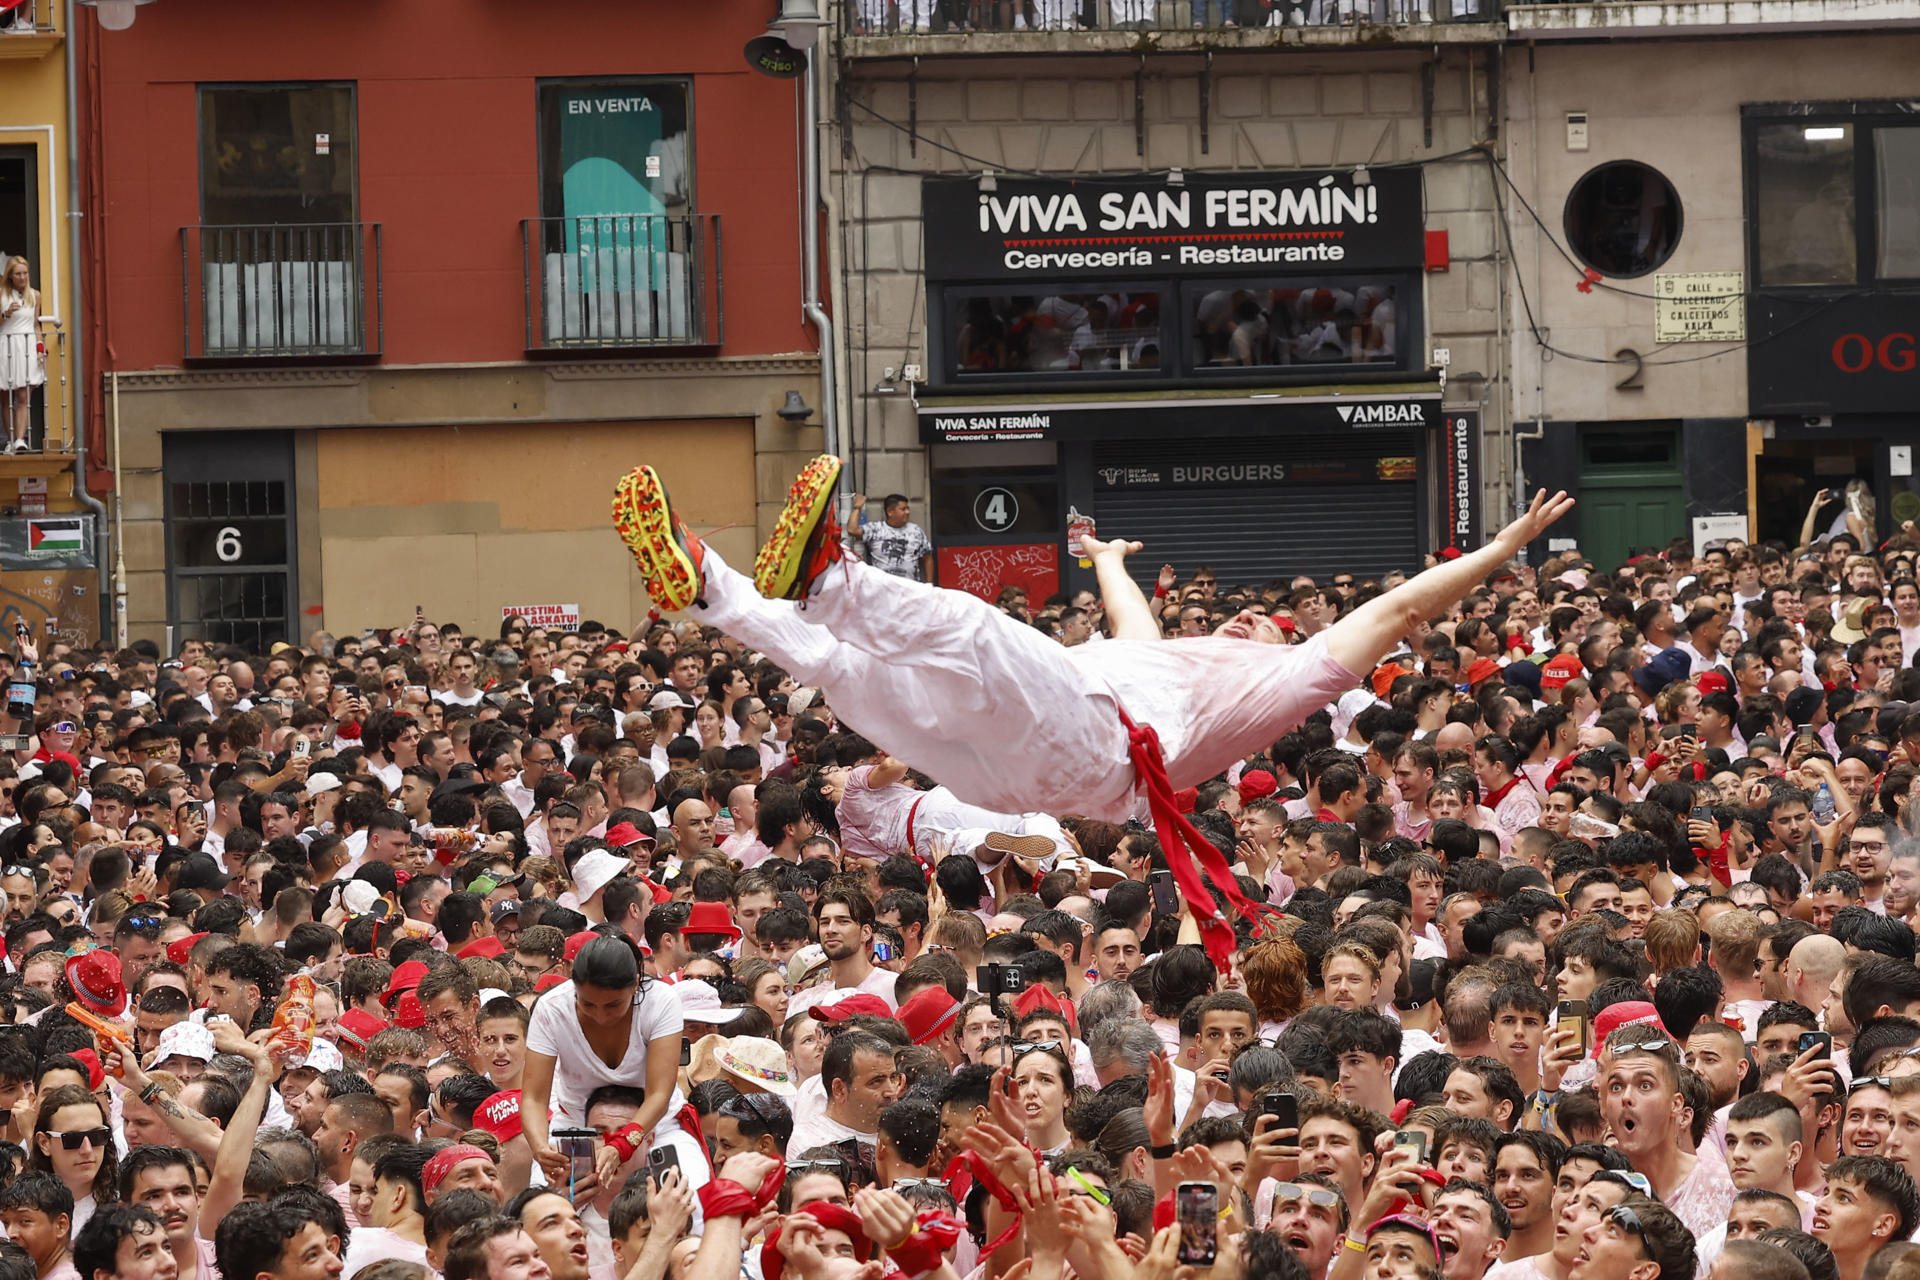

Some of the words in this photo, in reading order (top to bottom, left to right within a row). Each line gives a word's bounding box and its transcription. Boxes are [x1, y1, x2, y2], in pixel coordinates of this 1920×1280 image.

[568, 100, 592, 114] EN
[595, 98, 653, 113] VENTA
[978, 193, 1088, 234] ¡VIVA
[1099, 191, 1191, 231] SAN
[1205, 175, 1378, 227] FERMÍN!
[1004, 246, 1153, 269] Cervecería
[1180, 242, 1345, 265] Restaurante
[1686, 284, 1711, 293] CALLE
[1670, 310, 1729, 320] CALCETEROS
[1832, 333, 1917, 373] OG
[1614, 348, 1644, 391] 2
[969, 417, 997, 430] SAN
[999, 413, 1050, 428] FERMÍN!
[1352, 404, 1425, 422] AMBAR
[945, 433, 989, 441] Cervecería
[995, 432, 1044, 440] Restaurante
[1172, 464, 1285, 482] BURGUERS
[1455, 417, 1470, 534] Restaurante
[985, 494, 1008, 525] 4
[216, 526, 242, 562] 6
[503, 606, 563, 616] PALESTINA
[531, 615, 578, 624] ASKATU!
[1619, 1014, 1659, 1030] Cruzcampo
[486, 1099, 511, 1118] PLATA
[493, 1103, 519, 1124] PLOMO
